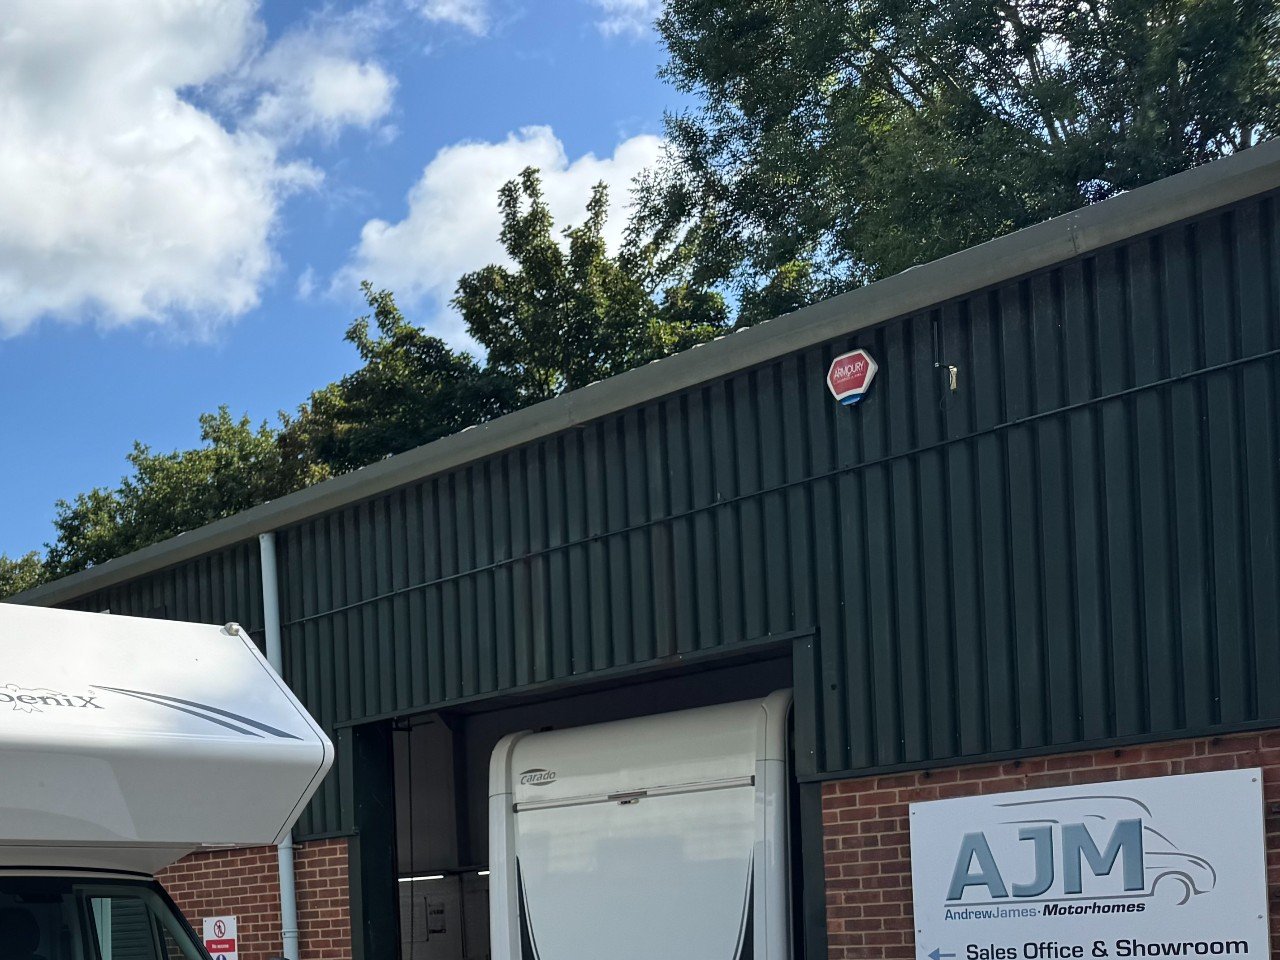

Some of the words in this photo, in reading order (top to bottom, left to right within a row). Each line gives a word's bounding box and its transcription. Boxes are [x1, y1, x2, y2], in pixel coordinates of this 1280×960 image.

[946, 818, 1145, 901] AJM
[966, 943, 1018, 960] Sales
[1023, 941, 1084, 960] Office
[1091, 940, 1109, 958] &
[1115, 939, 1250, 958] Showroom
